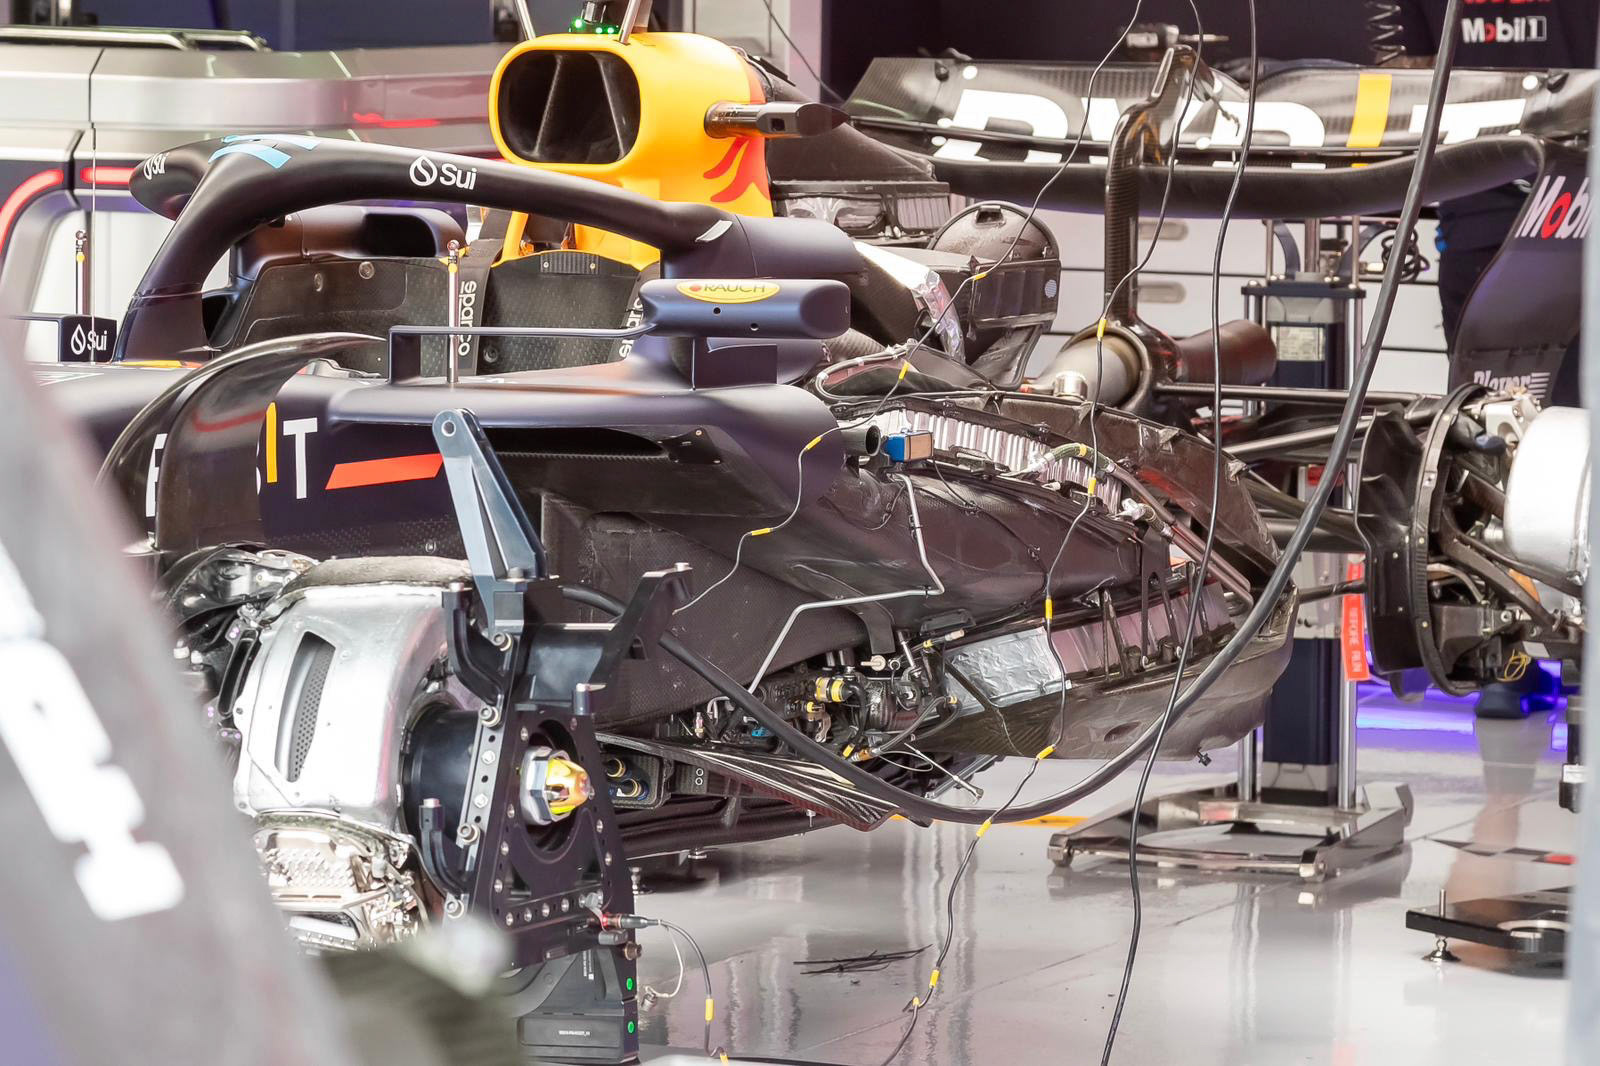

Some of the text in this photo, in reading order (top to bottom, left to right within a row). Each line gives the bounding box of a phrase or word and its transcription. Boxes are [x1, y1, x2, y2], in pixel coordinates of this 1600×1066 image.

[440, 163, 477, 190] Sui
[704, 283, 766, 293] RAUCH
[87, 330, 107, 351] Sui
